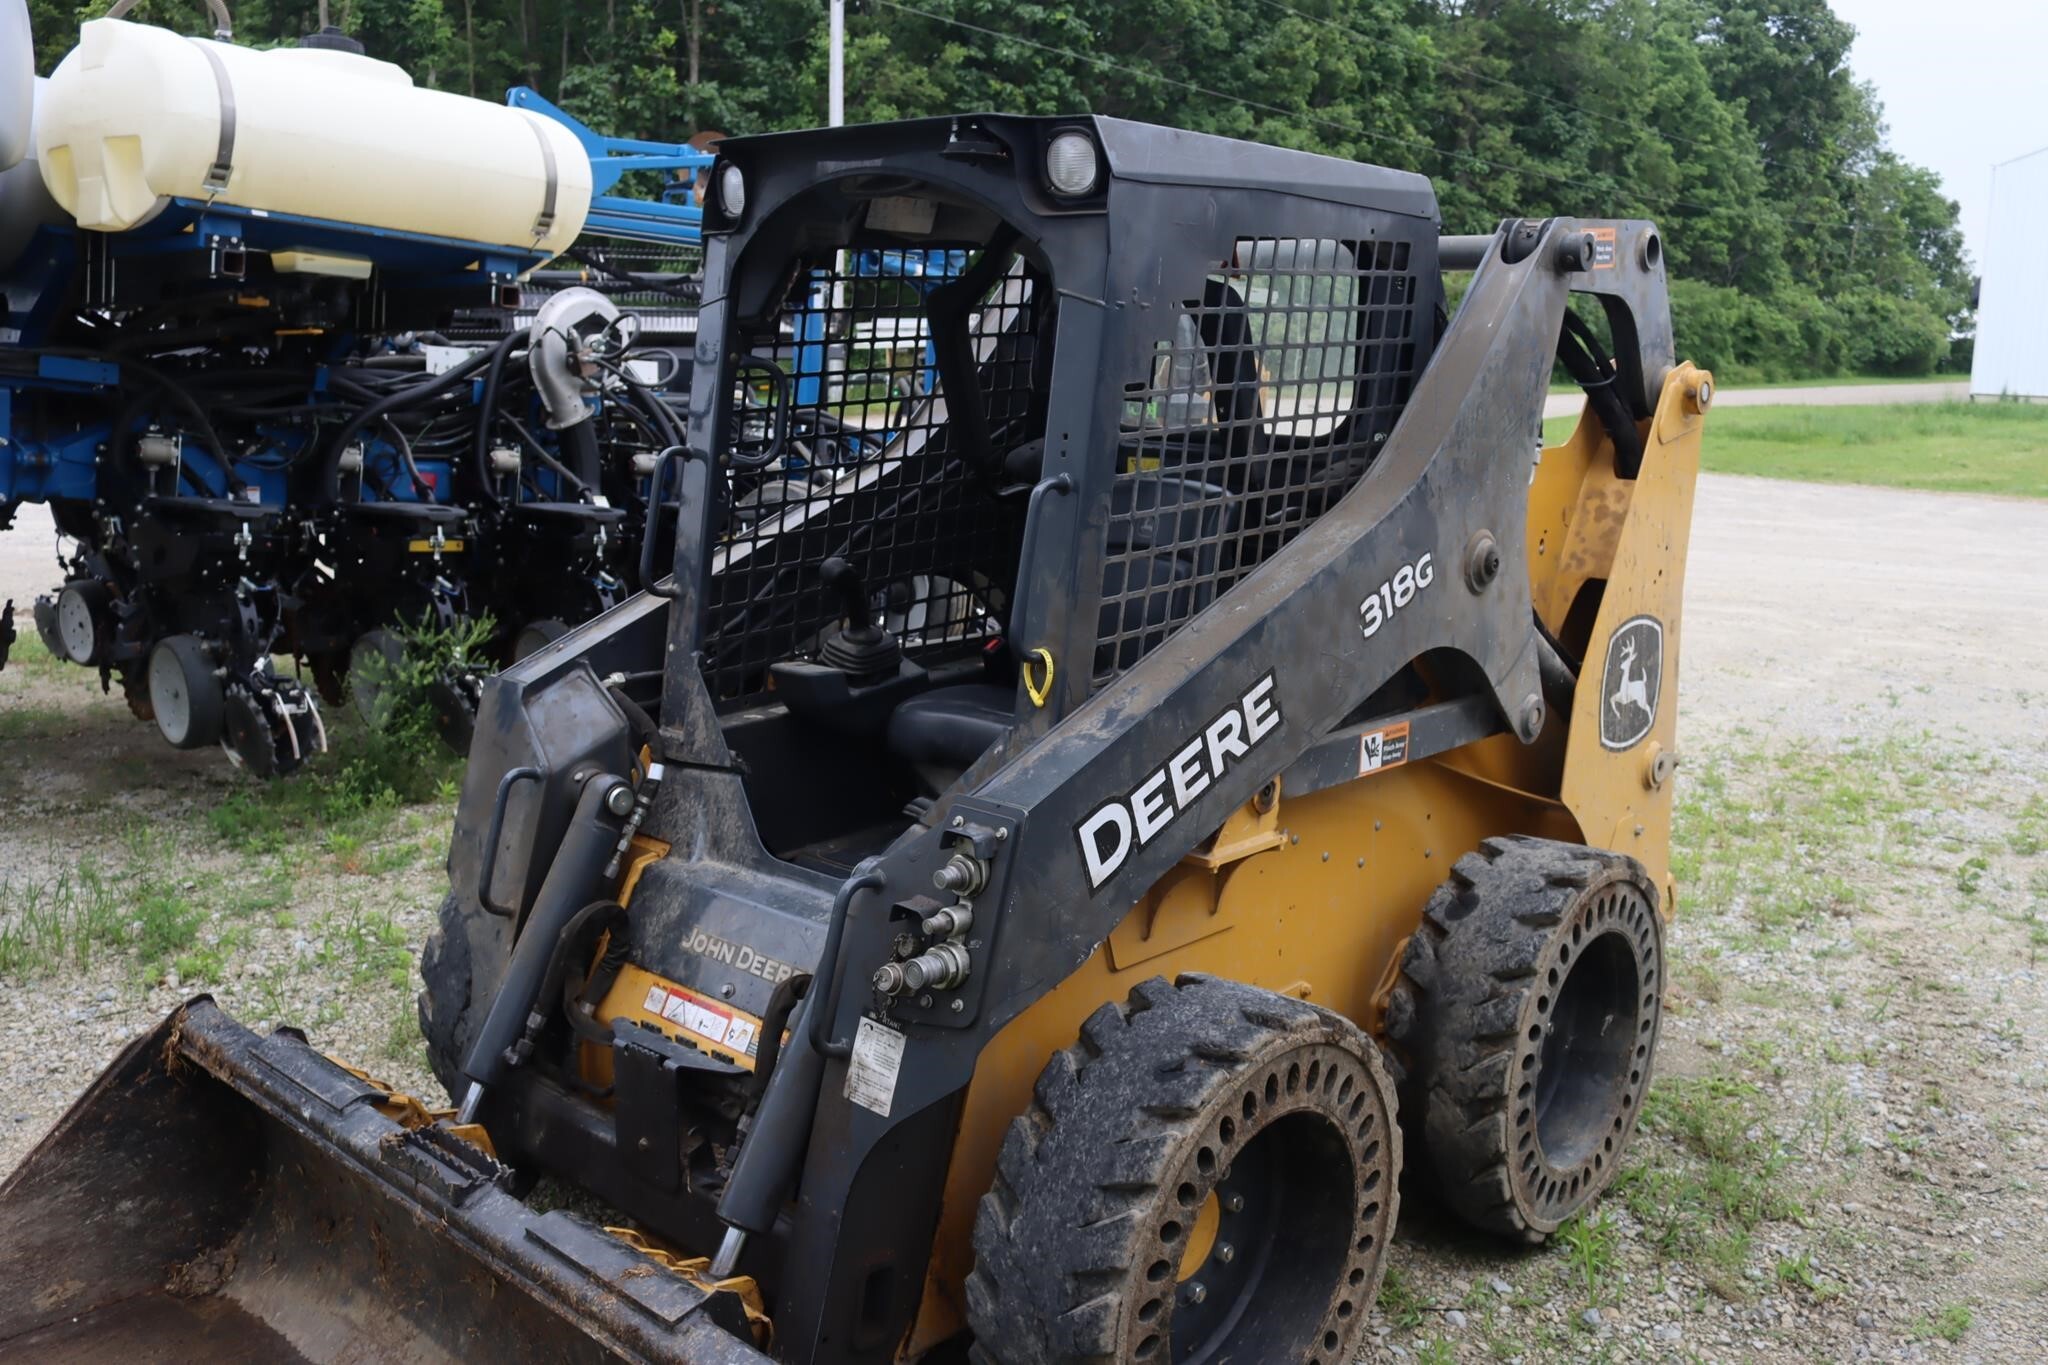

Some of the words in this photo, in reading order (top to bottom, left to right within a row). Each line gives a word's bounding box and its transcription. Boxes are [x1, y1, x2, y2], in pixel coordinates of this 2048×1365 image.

[1359, 552, 1434, 638] 318G
[1078, 674, 1280, 889] DEERE
[681, 926, 735, 965] JOHN
